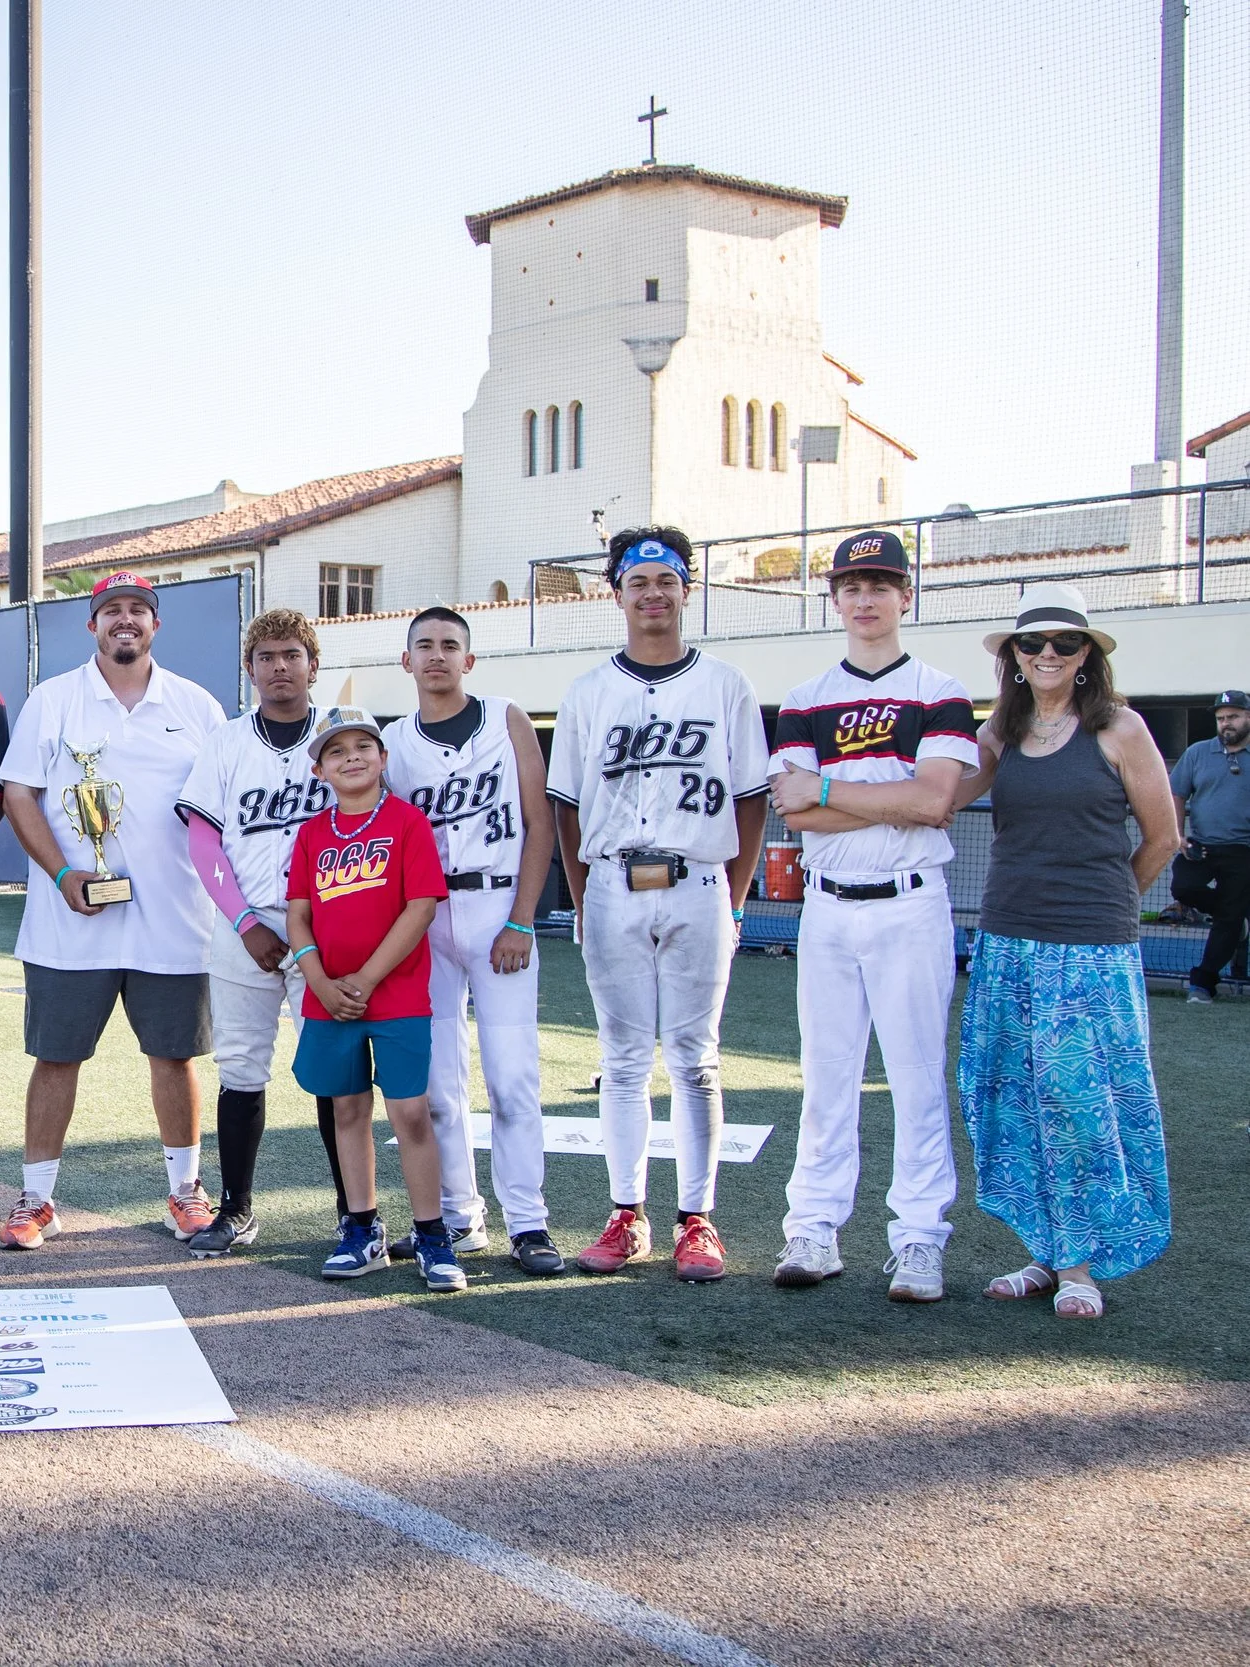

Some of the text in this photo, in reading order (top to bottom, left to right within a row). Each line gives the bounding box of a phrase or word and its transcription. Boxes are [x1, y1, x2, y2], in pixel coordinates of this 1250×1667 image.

[849, 538, 883, 558] 365
[602, 719, 717, 767] 365
[835, 704, 903, 744] 365
[238, 777, 331, 826] 365
[676, 770, 729, 818] 29
[484, 801, 517, 848] 31
[315, 837, 394, 890] 365
